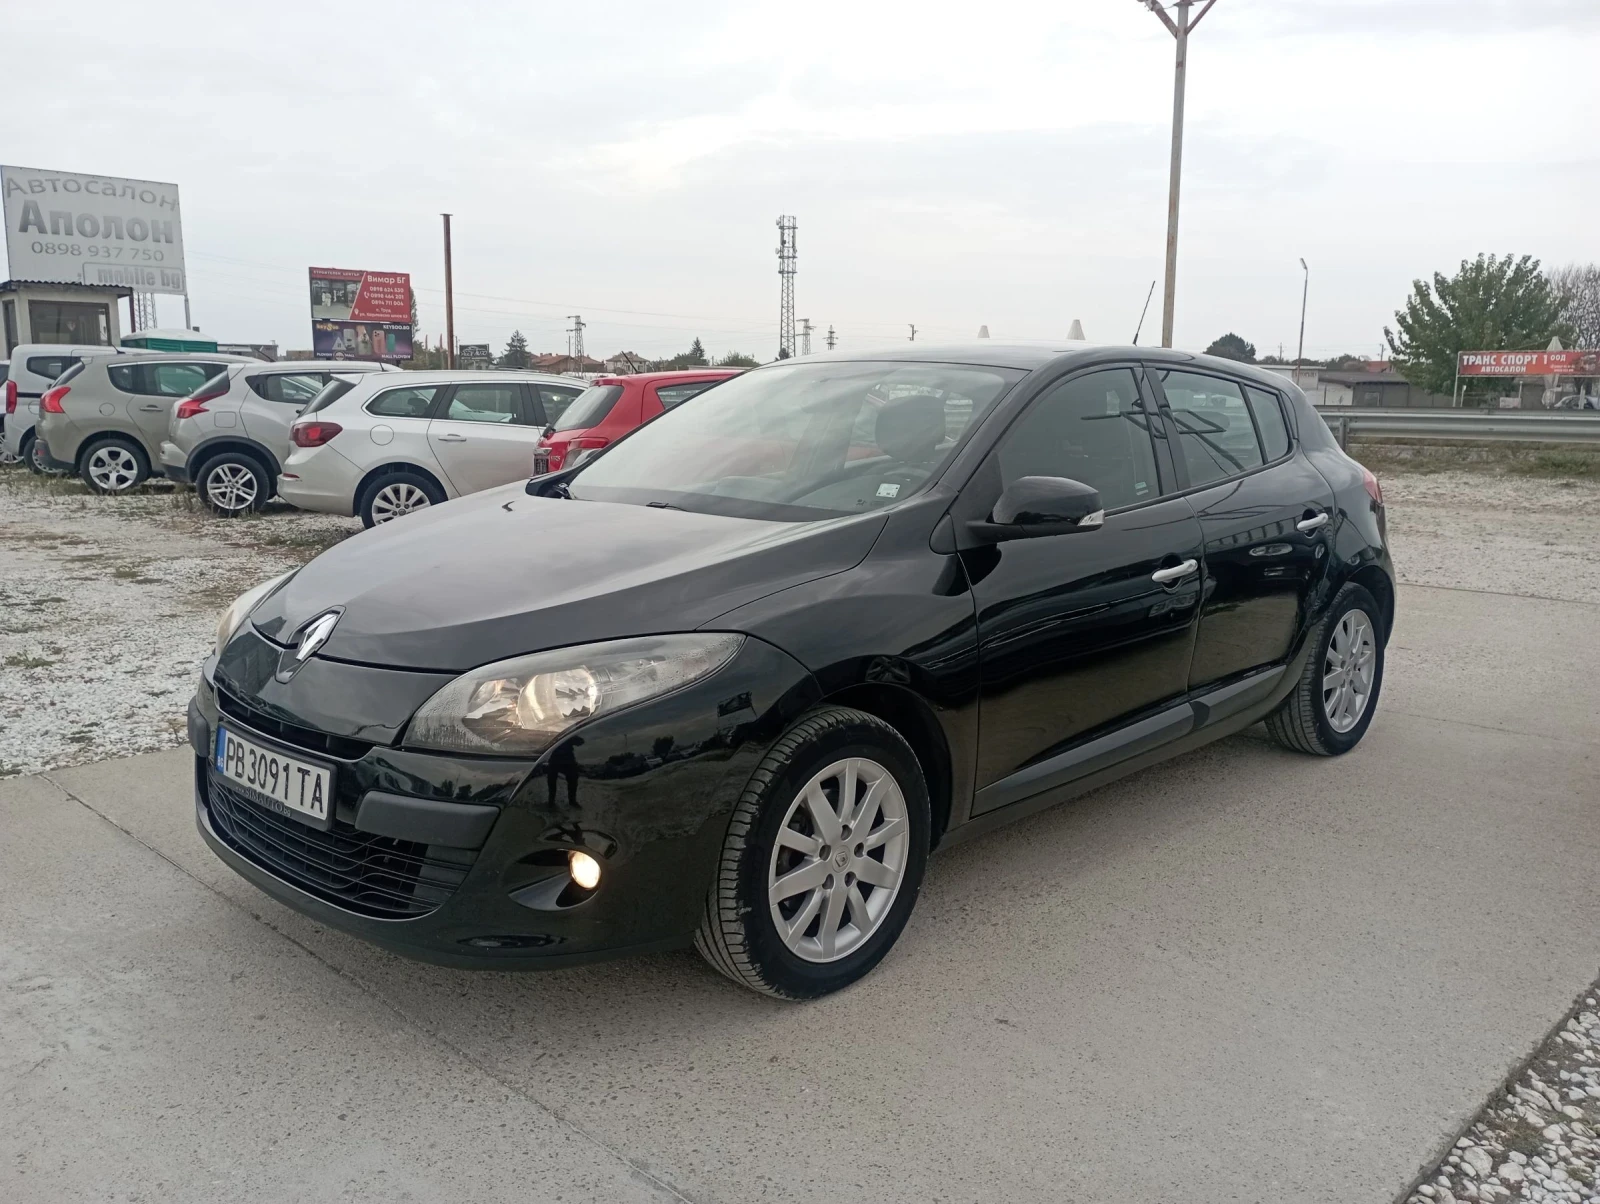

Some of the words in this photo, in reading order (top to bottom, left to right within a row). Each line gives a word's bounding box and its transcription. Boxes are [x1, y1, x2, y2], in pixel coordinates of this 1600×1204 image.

[6, 177, 178, 212] Автосалон
[18, 199, 174, 244] Аполон
[31, 241, 82, 256] 0898
[88, 245, 123, 259] 937
[130, 248, 164, 262] 750
[367, 275, 395, 285] Вимар
[396, 276, 406, 284] БГ
[1462, 355, 1496, 365] ТРАНС
[1501, 354, 1538, 365] СПОРТ
[1543, 354, 1548, 365] 1
